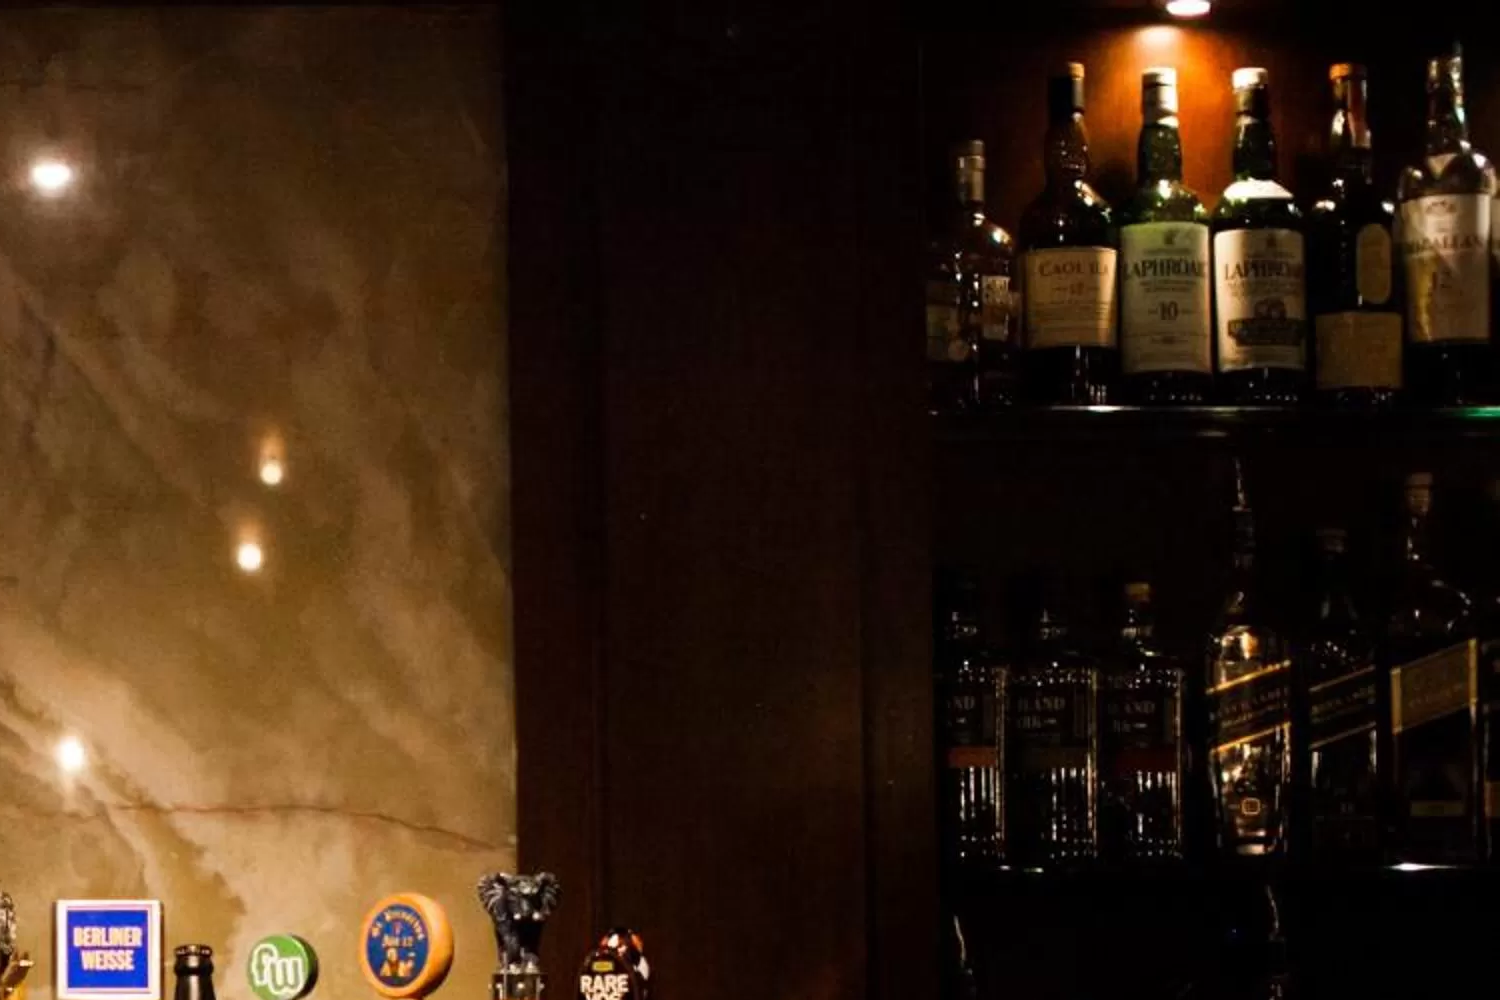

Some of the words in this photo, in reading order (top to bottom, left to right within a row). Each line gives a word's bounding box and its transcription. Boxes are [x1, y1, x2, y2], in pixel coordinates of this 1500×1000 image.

[1159, 301, 1179, 322] 10
[72, 926, 143, 948] BERLINER
[80, 949, 136, 971] WEISSE
[579, 973, 630, 994] RARE
